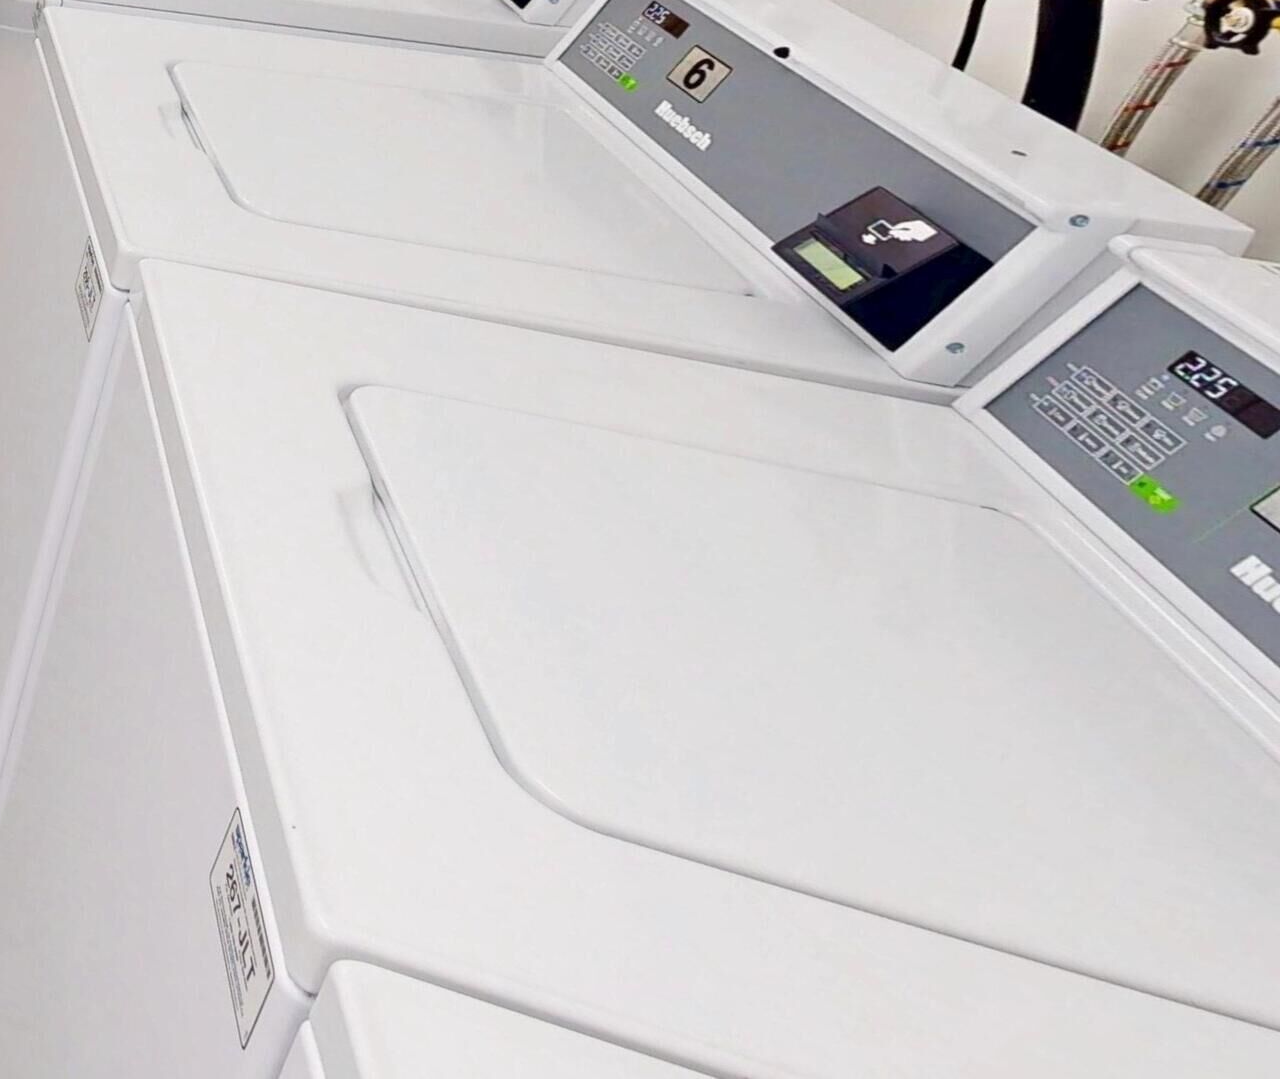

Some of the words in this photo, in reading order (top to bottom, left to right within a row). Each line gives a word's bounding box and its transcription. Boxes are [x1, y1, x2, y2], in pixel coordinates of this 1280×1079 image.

[682, 57, 716, 90] 6
[654, 99, 712, 152] Huebsch
[225, 863, 256, 982] 267-JLT
